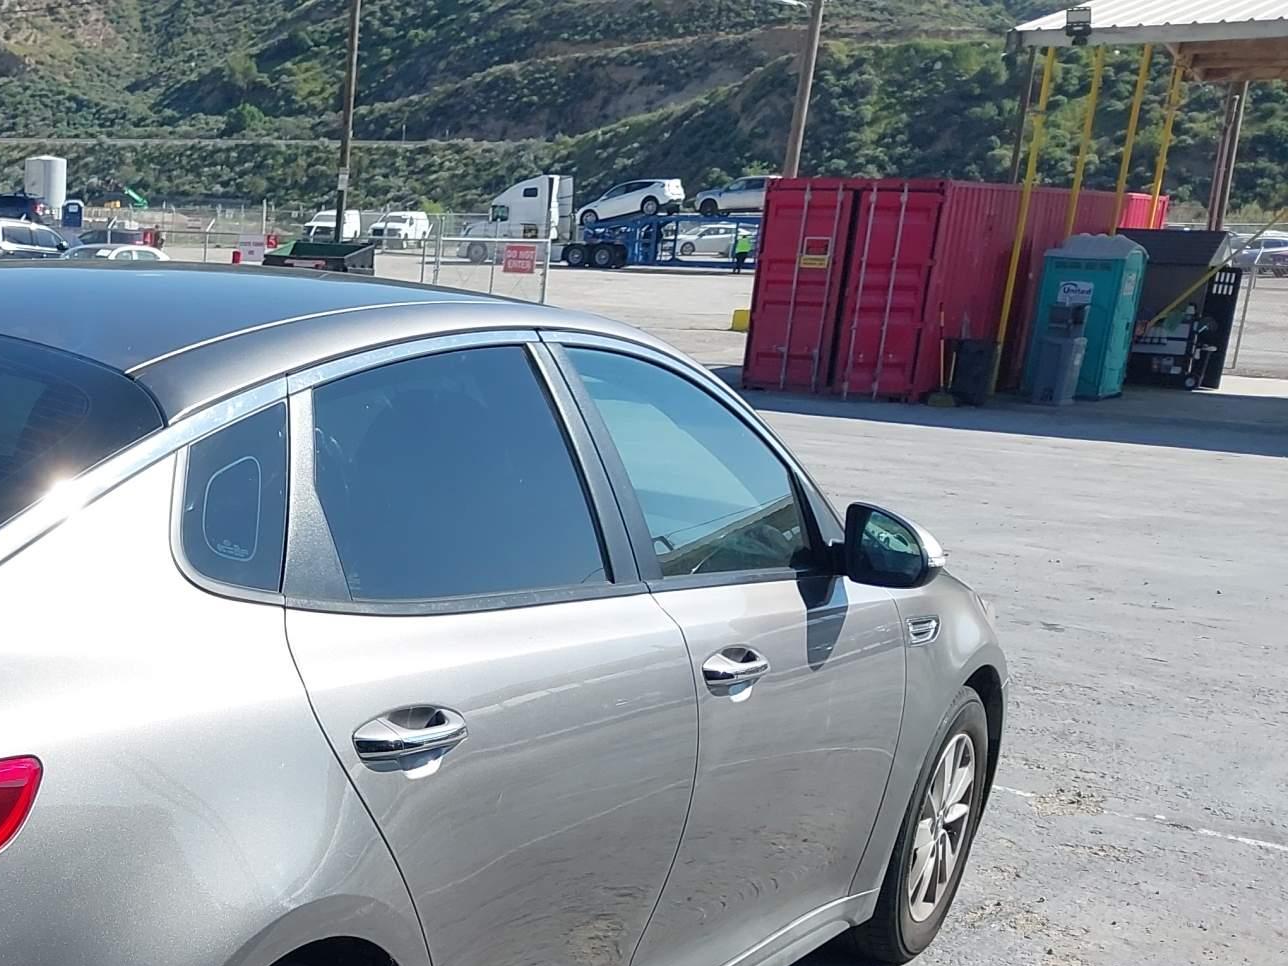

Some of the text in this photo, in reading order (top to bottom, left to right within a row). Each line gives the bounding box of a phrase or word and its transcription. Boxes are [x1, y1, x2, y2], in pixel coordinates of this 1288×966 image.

[506, 249, 534, 259] DO NOT
[1063, 287, 1092, 295] United
